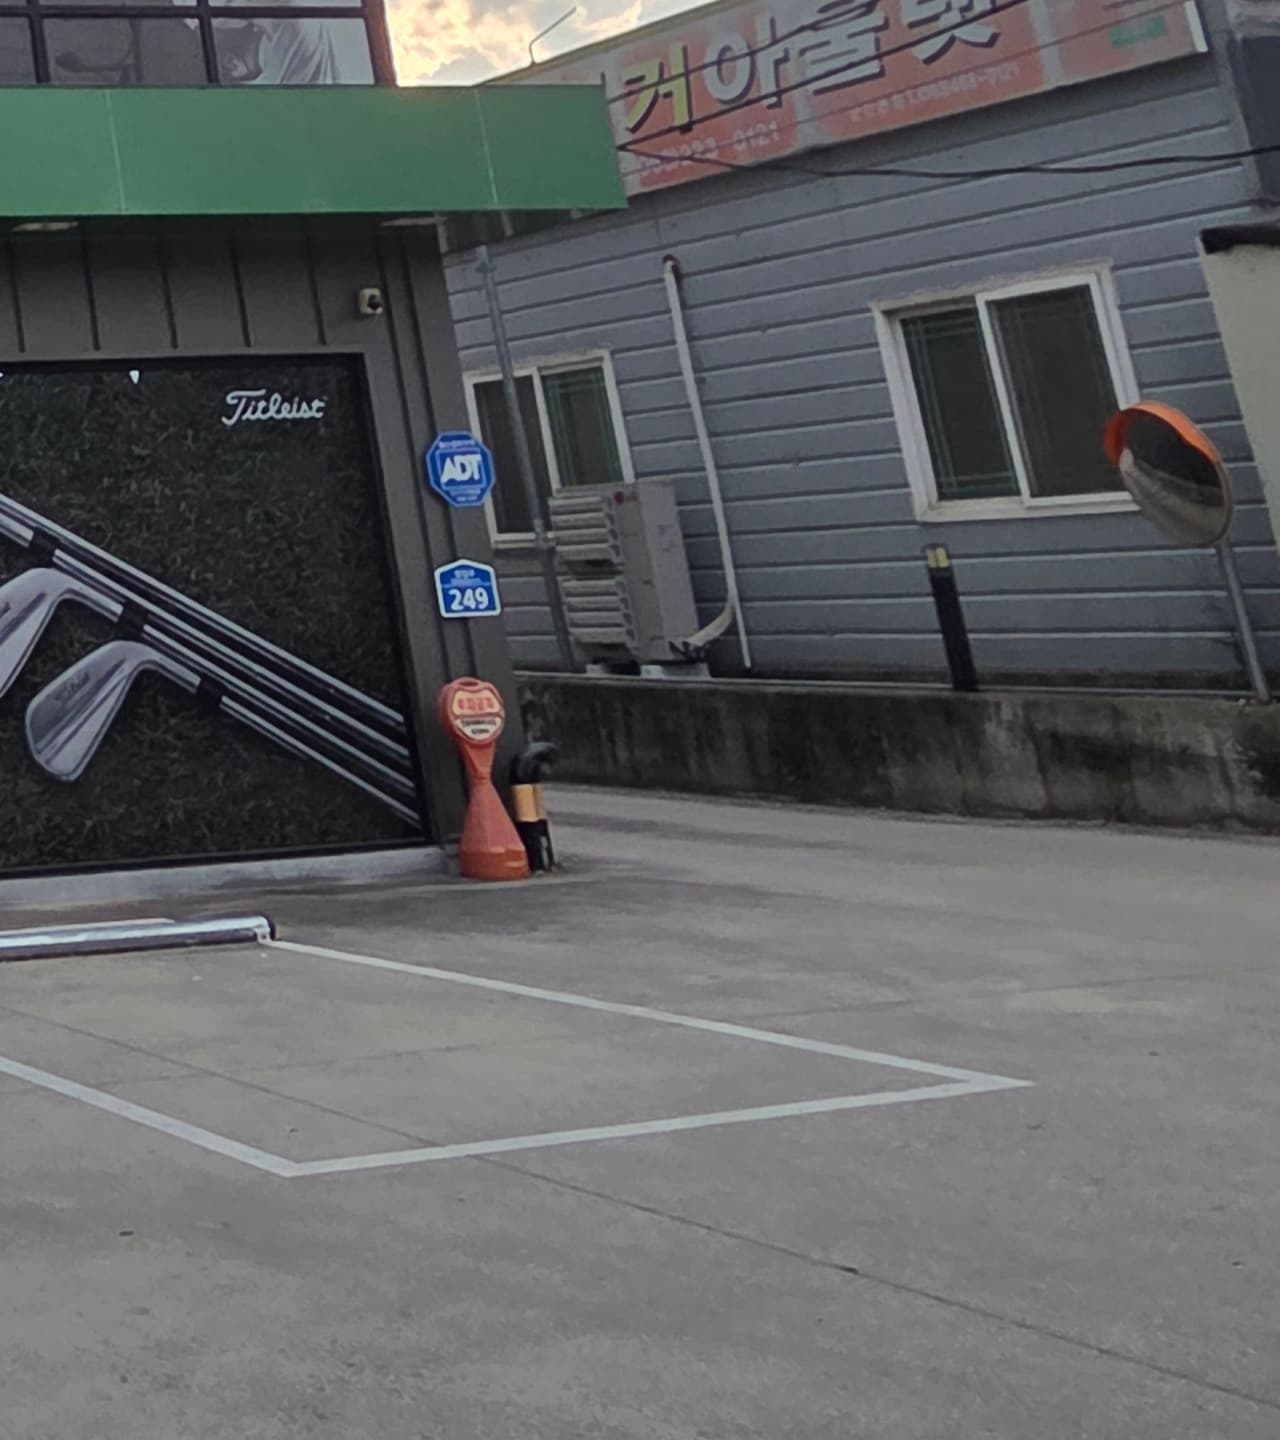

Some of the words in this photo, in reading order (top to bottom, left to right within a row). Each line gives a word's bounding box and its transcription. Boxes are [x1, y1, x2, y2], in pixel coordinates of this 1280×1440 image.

[221, 388, 326, 427] Titleist
[441, 453, 482, 483] ADT
[447, 587, 489, 610] 249
